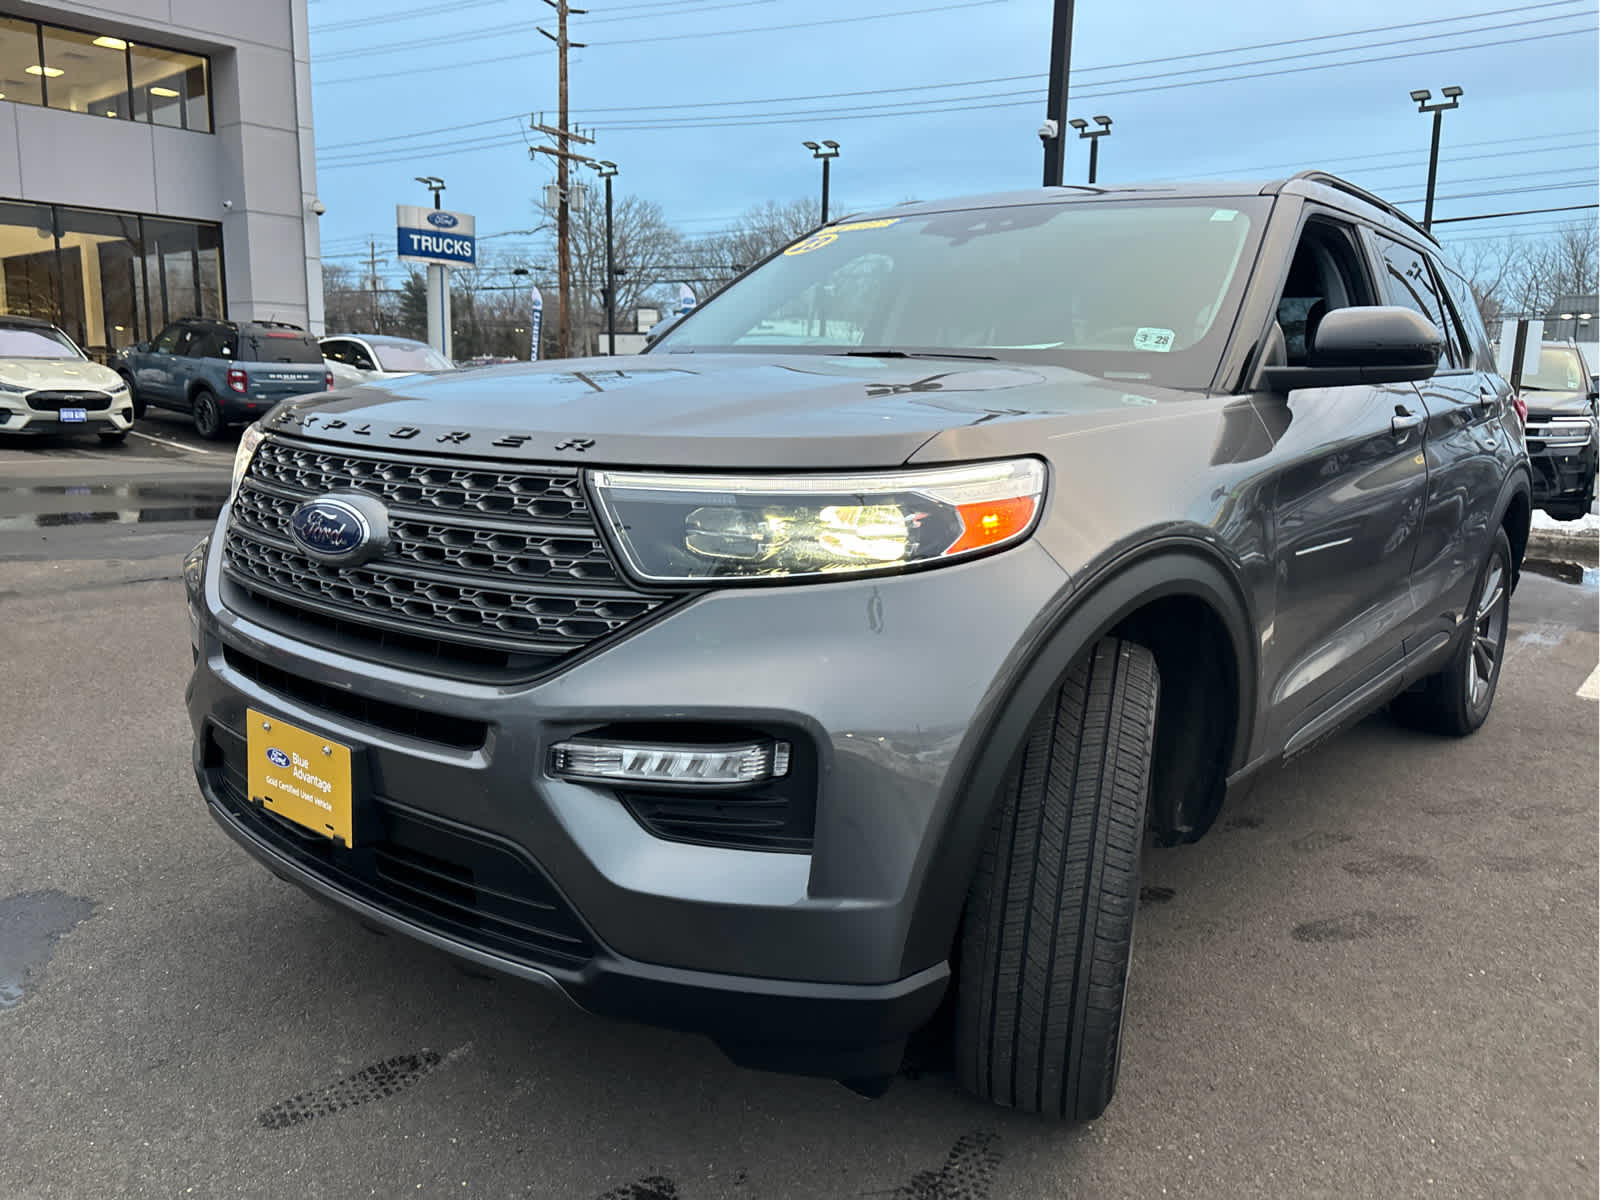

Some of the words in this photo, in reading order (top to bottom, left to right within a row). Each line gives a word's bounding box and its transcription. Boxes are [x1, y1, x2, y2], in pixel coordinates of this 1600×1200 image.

[409, 234, 472, 257] TRUCKS
[1154, 335, 1170, 345] 28
[303, 509, 347, 546] Ford
[292, 751, 309, 769] Blue
[266, 775, 278, 788] Gold
[279, 780, 299, 797] Certified
[300, 788, 313, 803] Used
[293, 765, 332, 793] Advantage
